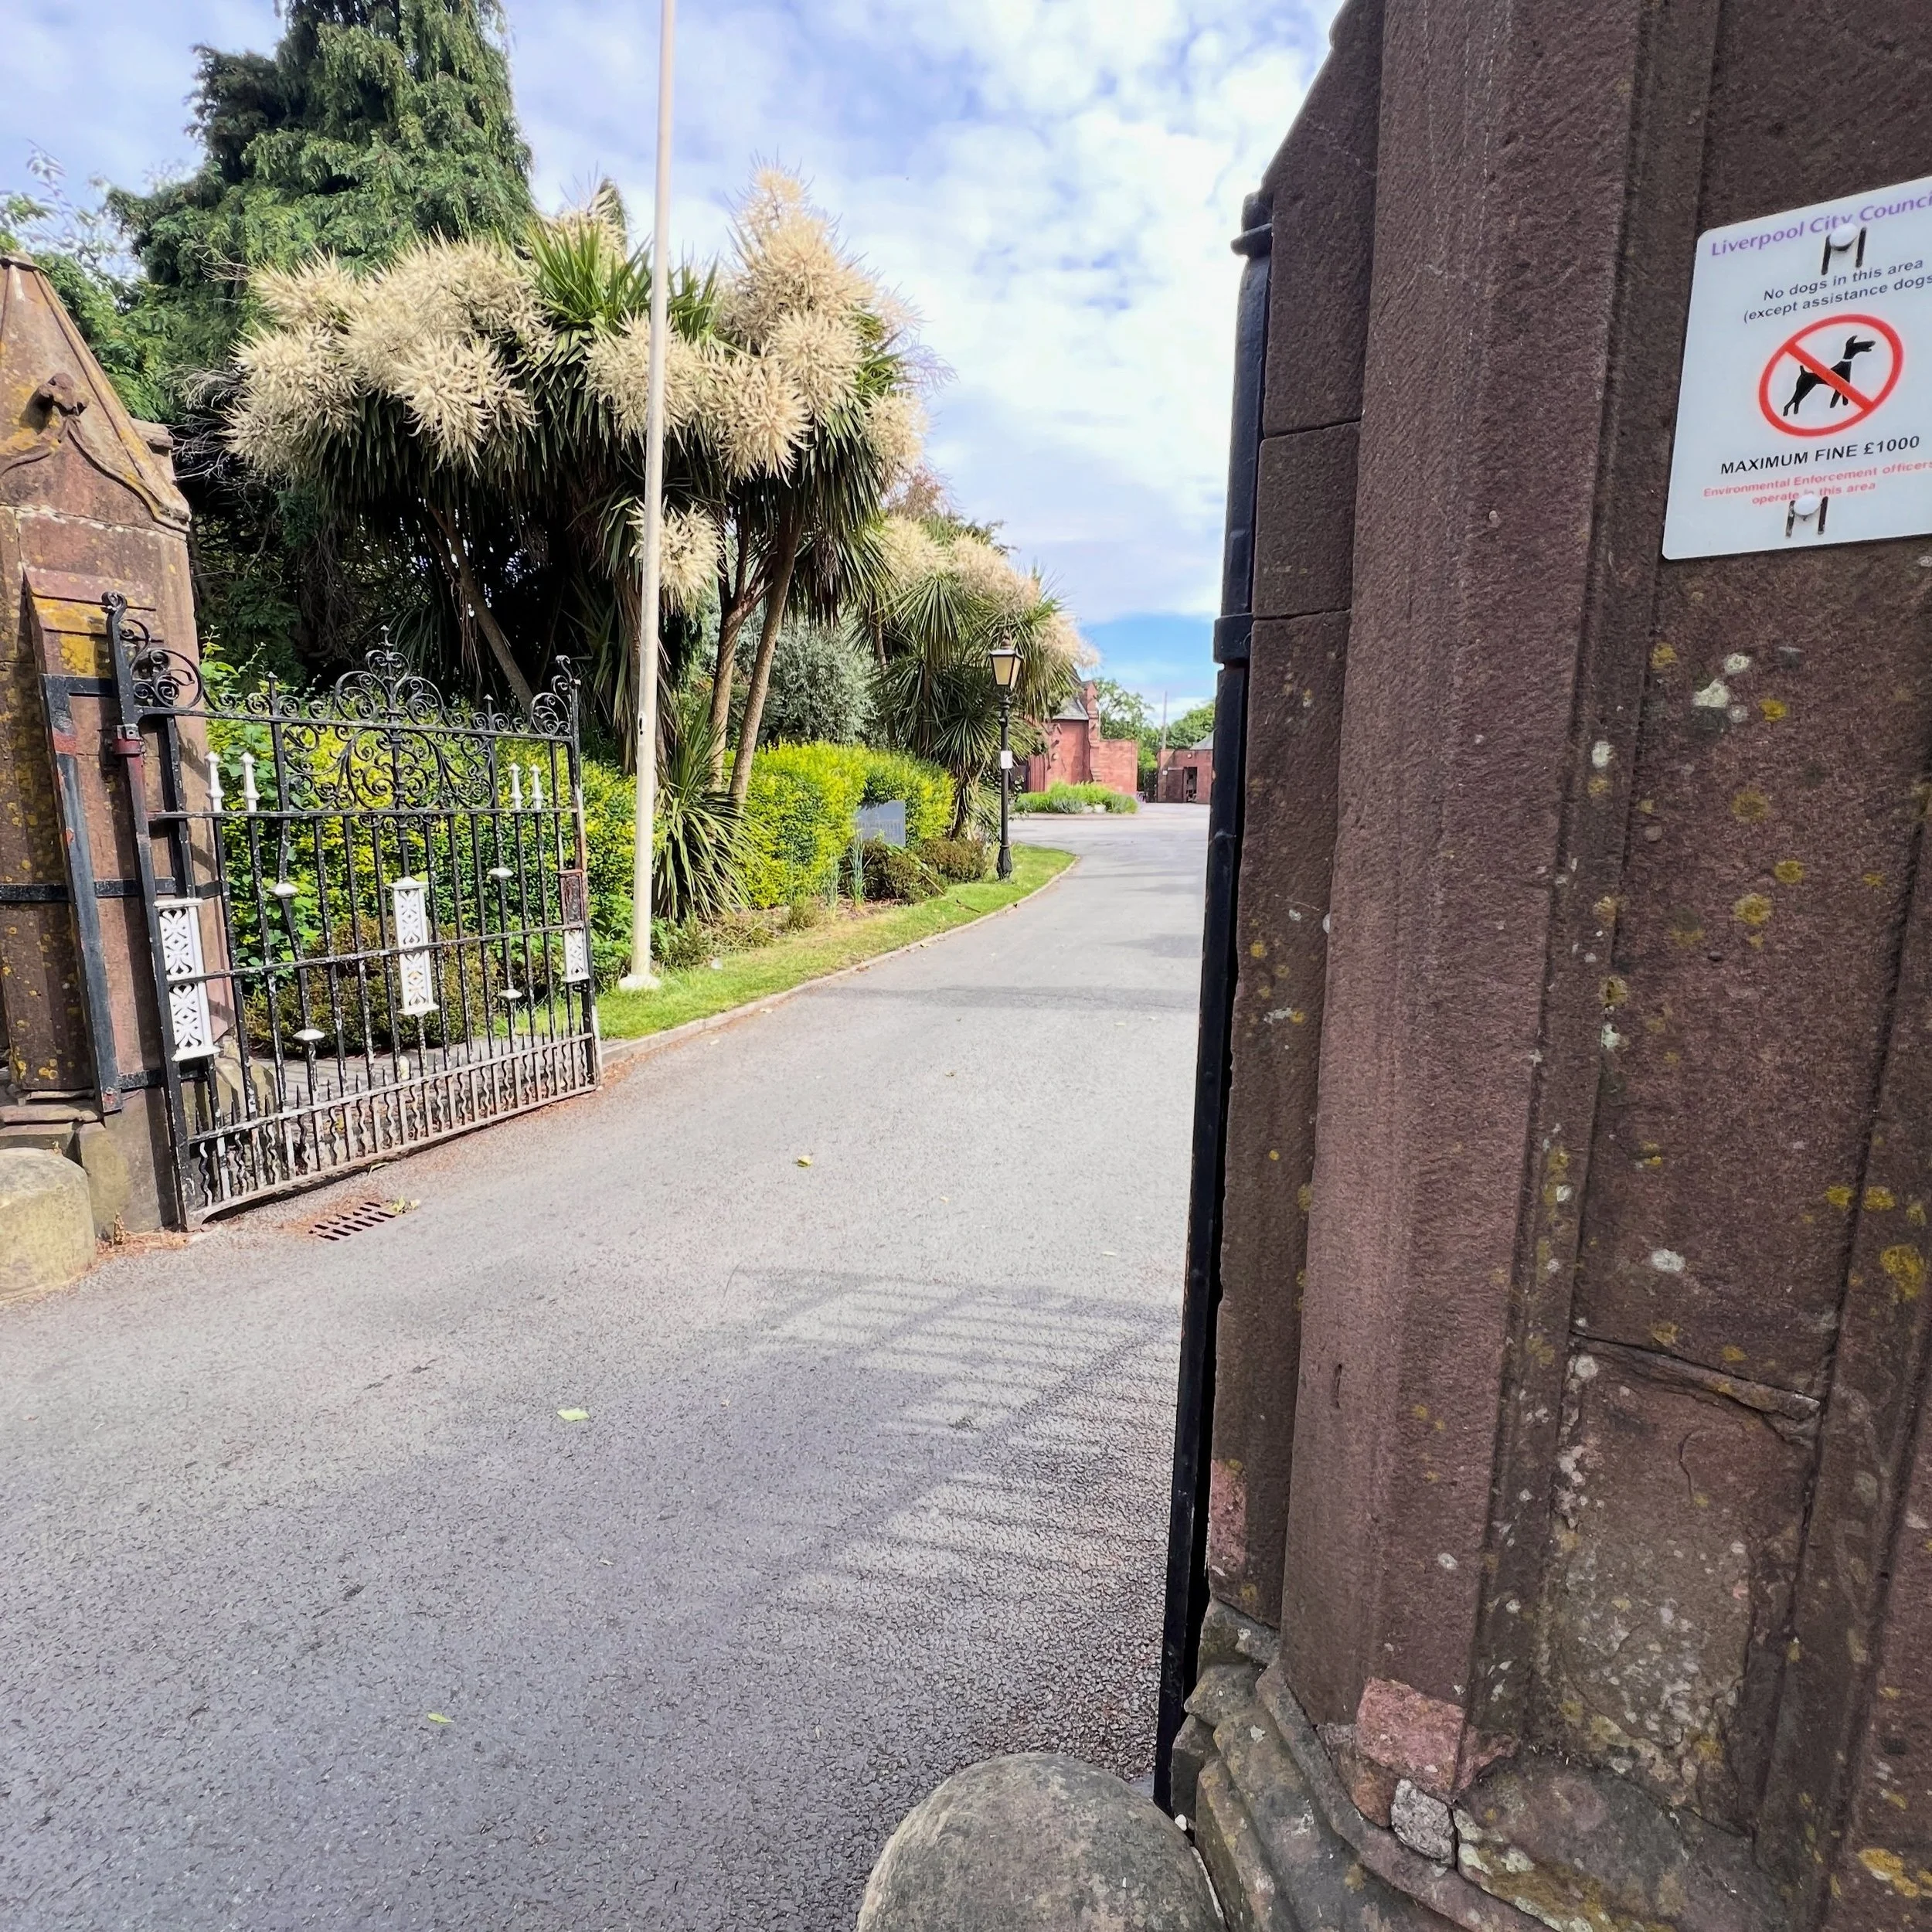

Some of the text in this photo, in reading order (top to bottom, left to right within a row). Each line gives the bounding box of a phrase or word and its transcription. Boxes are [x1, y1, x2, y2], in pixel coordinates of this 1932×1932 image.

[1711, 222, 1804, 256] Liverpool
[1763, 260, 1923, 301] No dogs in this area
[1743, 302, 1799, 324] (except
[1802, 284, 1888, 310] assistance
[1720, 435, 1920, 474] MAXIMUM FINE £1000
[1703, 478, 1791, 497] Environmental
[1794, 467, 1878, 486] Enforcement
[1752, 491, 1800, 505] operate
[1819, 484, 1842, 496] this
[1846, 482, 1876, 493] area
